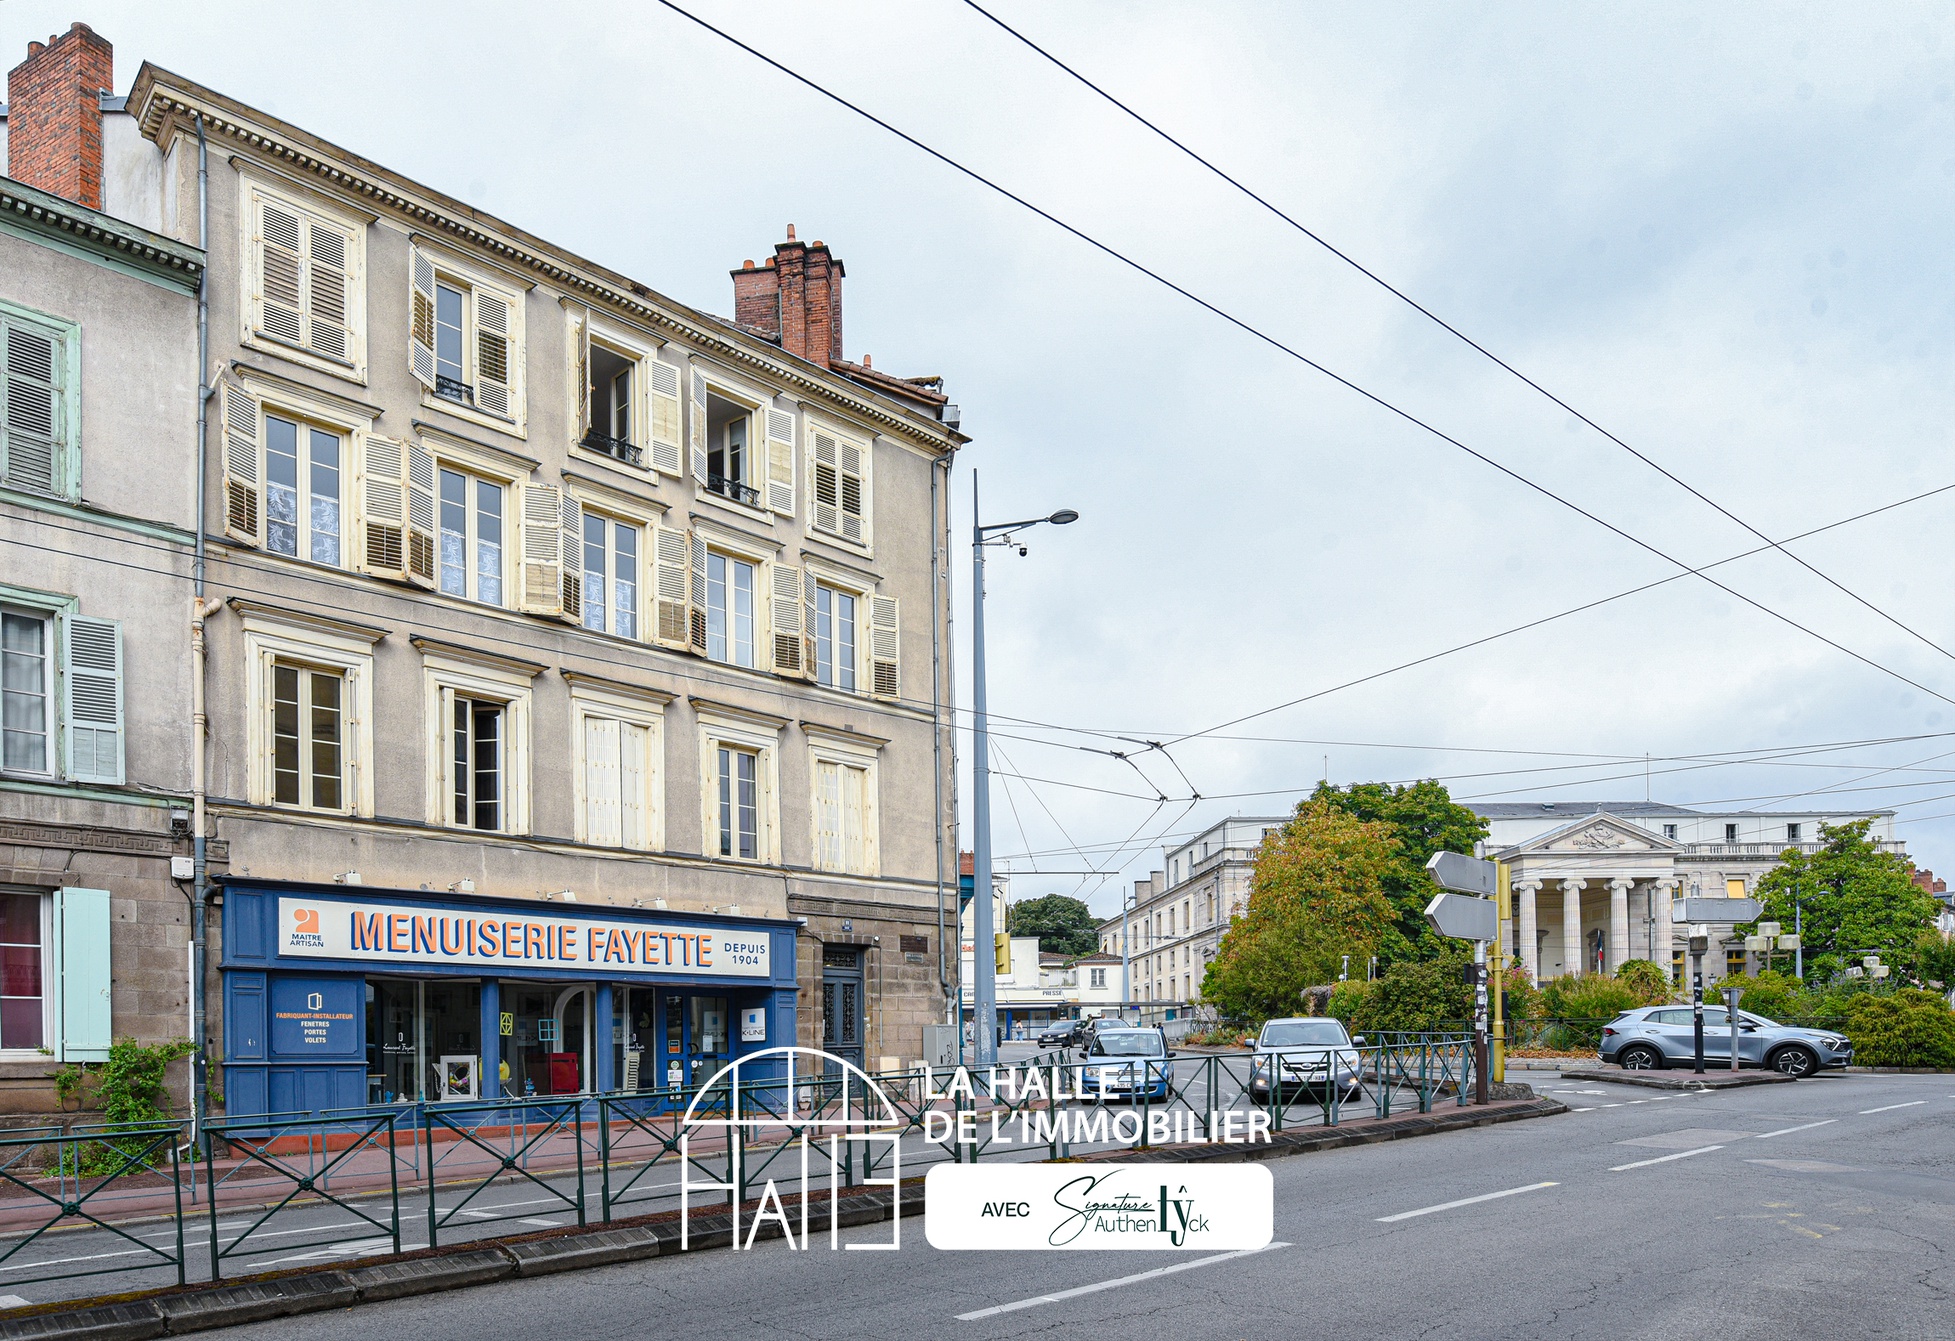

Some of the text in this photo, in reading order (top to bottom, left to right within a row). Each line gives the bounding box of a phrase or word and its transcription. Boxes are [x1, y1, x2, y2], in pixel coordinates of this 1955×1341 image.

[291, 933, 322, 941] MAITRE
[351, 911, 714, 967] MENUISERIE FAYETTE
[724, 943, 766, 954] DEPUIS
[732, 955, 759, 965] 1904
[276, 1012, 354, 1020] FABRIQUANT-INSTALLATEUR
